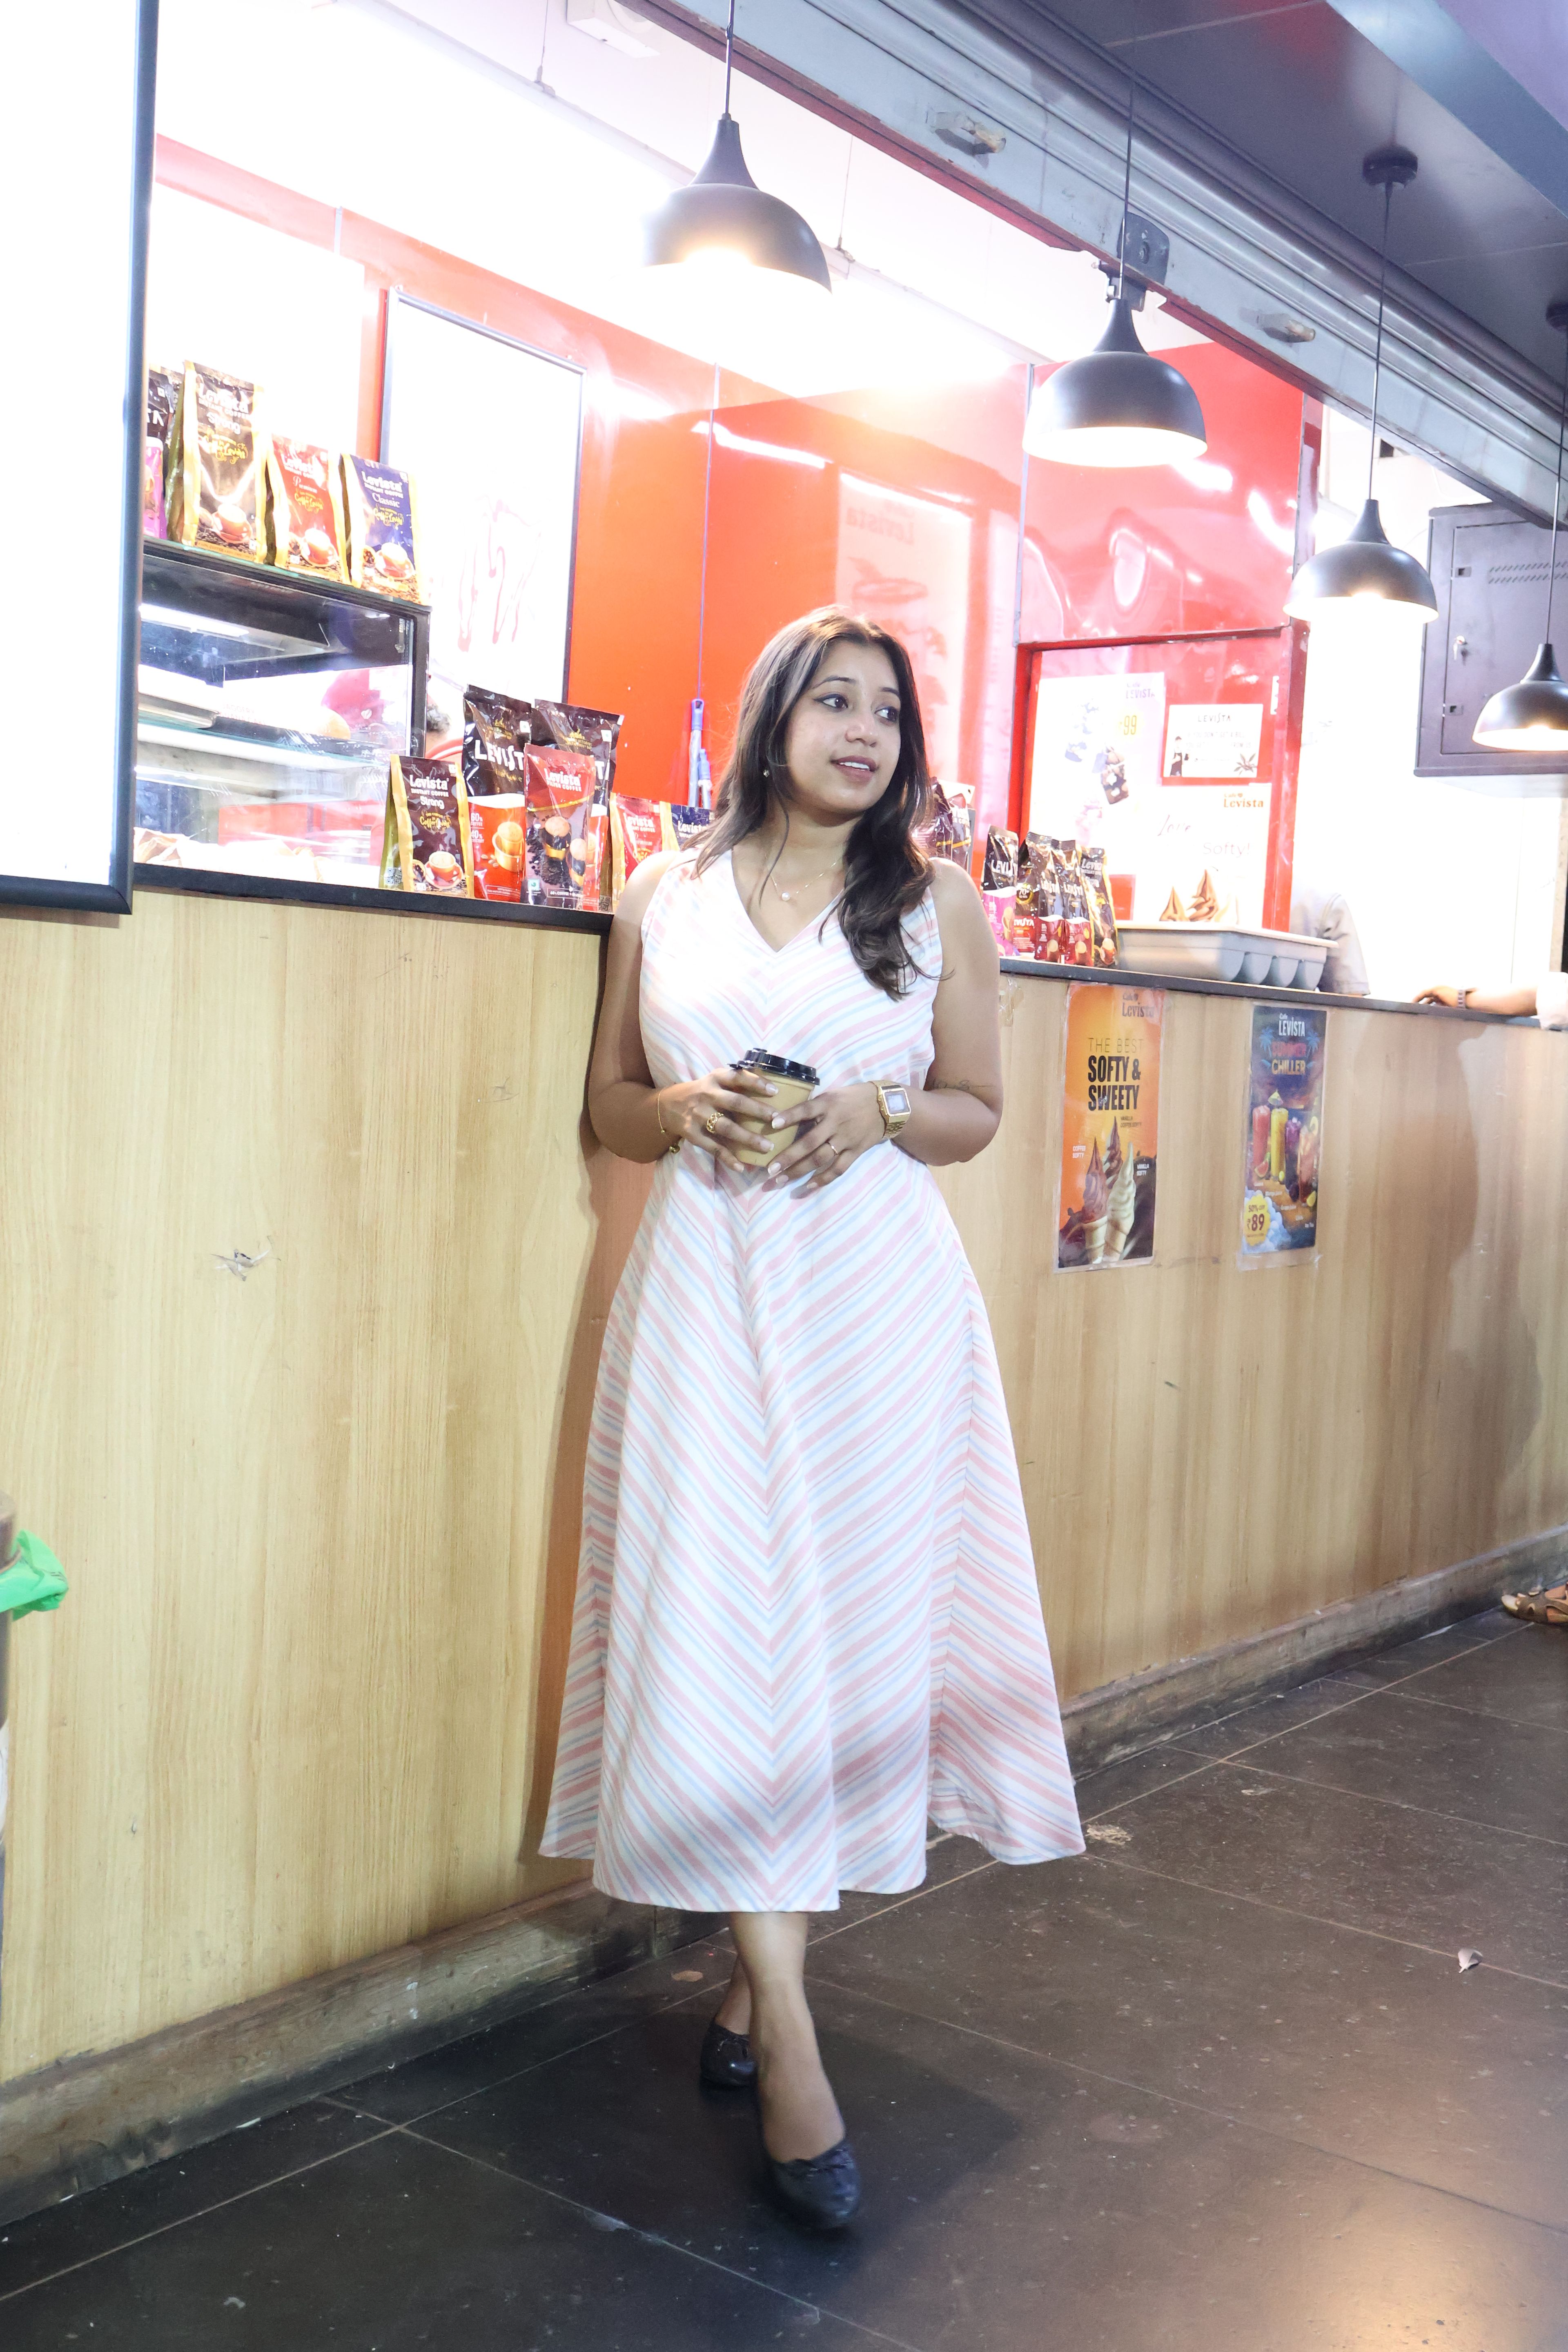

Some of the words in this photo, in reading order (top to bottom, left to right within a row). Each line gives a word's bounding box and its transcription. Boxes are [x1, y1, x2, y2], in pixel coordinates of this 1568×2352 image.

[293, 476, 317, 493] Premium
[362, 471, 403, 493] Levista
[372, 492, 400, 508] Classic
[1198, 713, 1231, 723] LEVISTA
[474, 739, 524, 771] LEVIST
[409, 775, 449, 791] Levista
[543, 768, 581, 786] Levista
[420, 796, 445, 809] Strong
[1224, 798, 1263, 808] Levista
[420, 816, 435, 828] Coffee
[471, 812, 483, 822] 60%
[1203, 842, 1250, 858] Softy!
[1122, 1002, 1155, 1018] Levista
[1278, 1017, 1305, 1037] LEVISTA
[1088, 1038, 1111, 1053] THE
[1116, 1038, 1145, 1053] BEST
[1272, 1041, 1307, 1057] SUMMER
[1088, 1055, 1129, 1082] SOFTY
[1131, 1058, 1141, 1080] &
[1272, 1059, 1306, 1075] CHILLER
[1088, 1085, 1140, 1111] SWEETY
